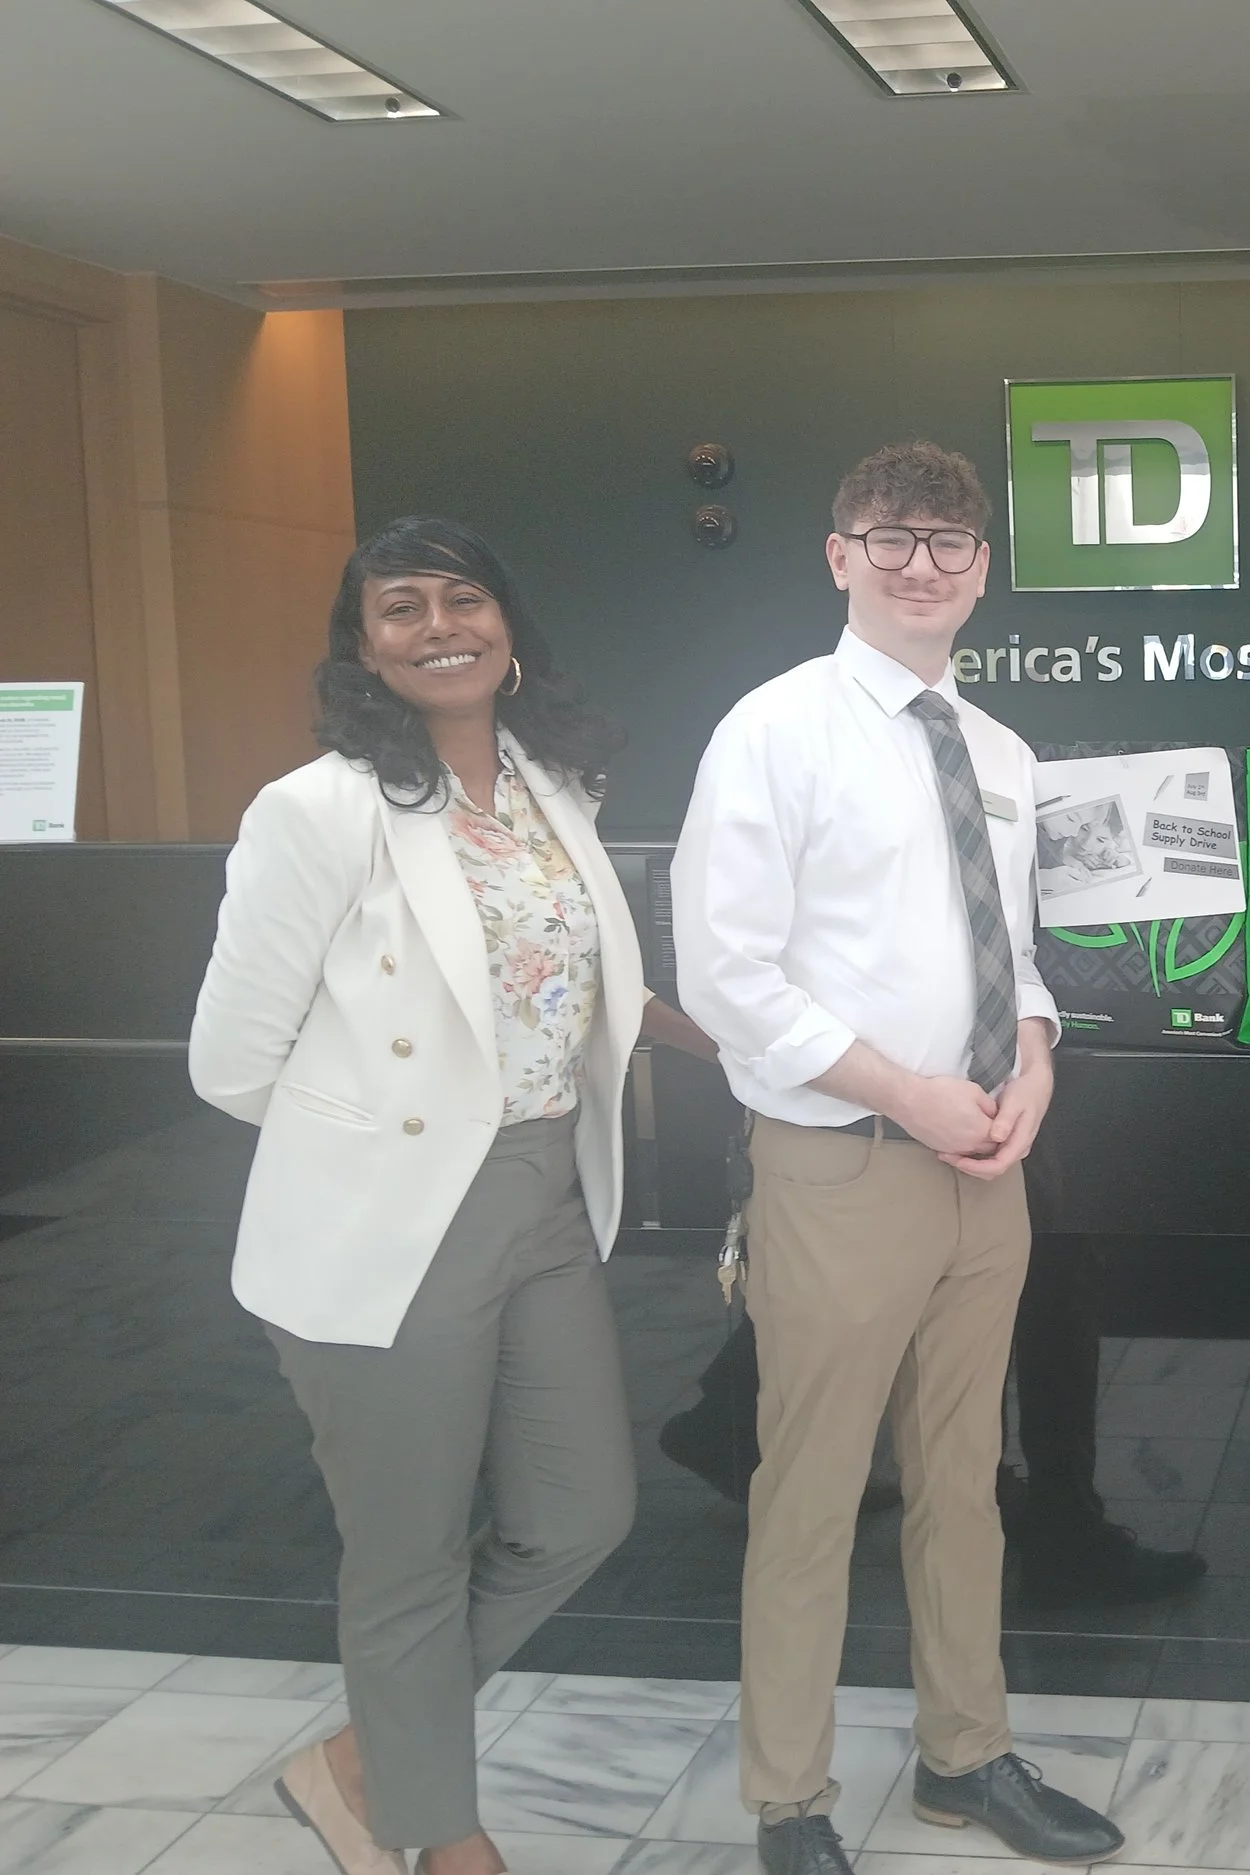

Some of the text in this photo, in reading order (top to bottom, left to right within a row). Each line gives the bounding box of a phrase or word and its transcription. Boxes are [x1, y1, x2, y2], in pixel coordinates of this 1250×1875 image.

[1031, 419, 1212, 545] TD
[952, 634, 1123, 683] erica's
[1153, 820, 1231, 840] Back to School
[1151, 832, 1217, 850] Supply Drive
[1170, 861, 1233, 877] Donate Here
[1194, 1013, 1224, 1023] Bank
